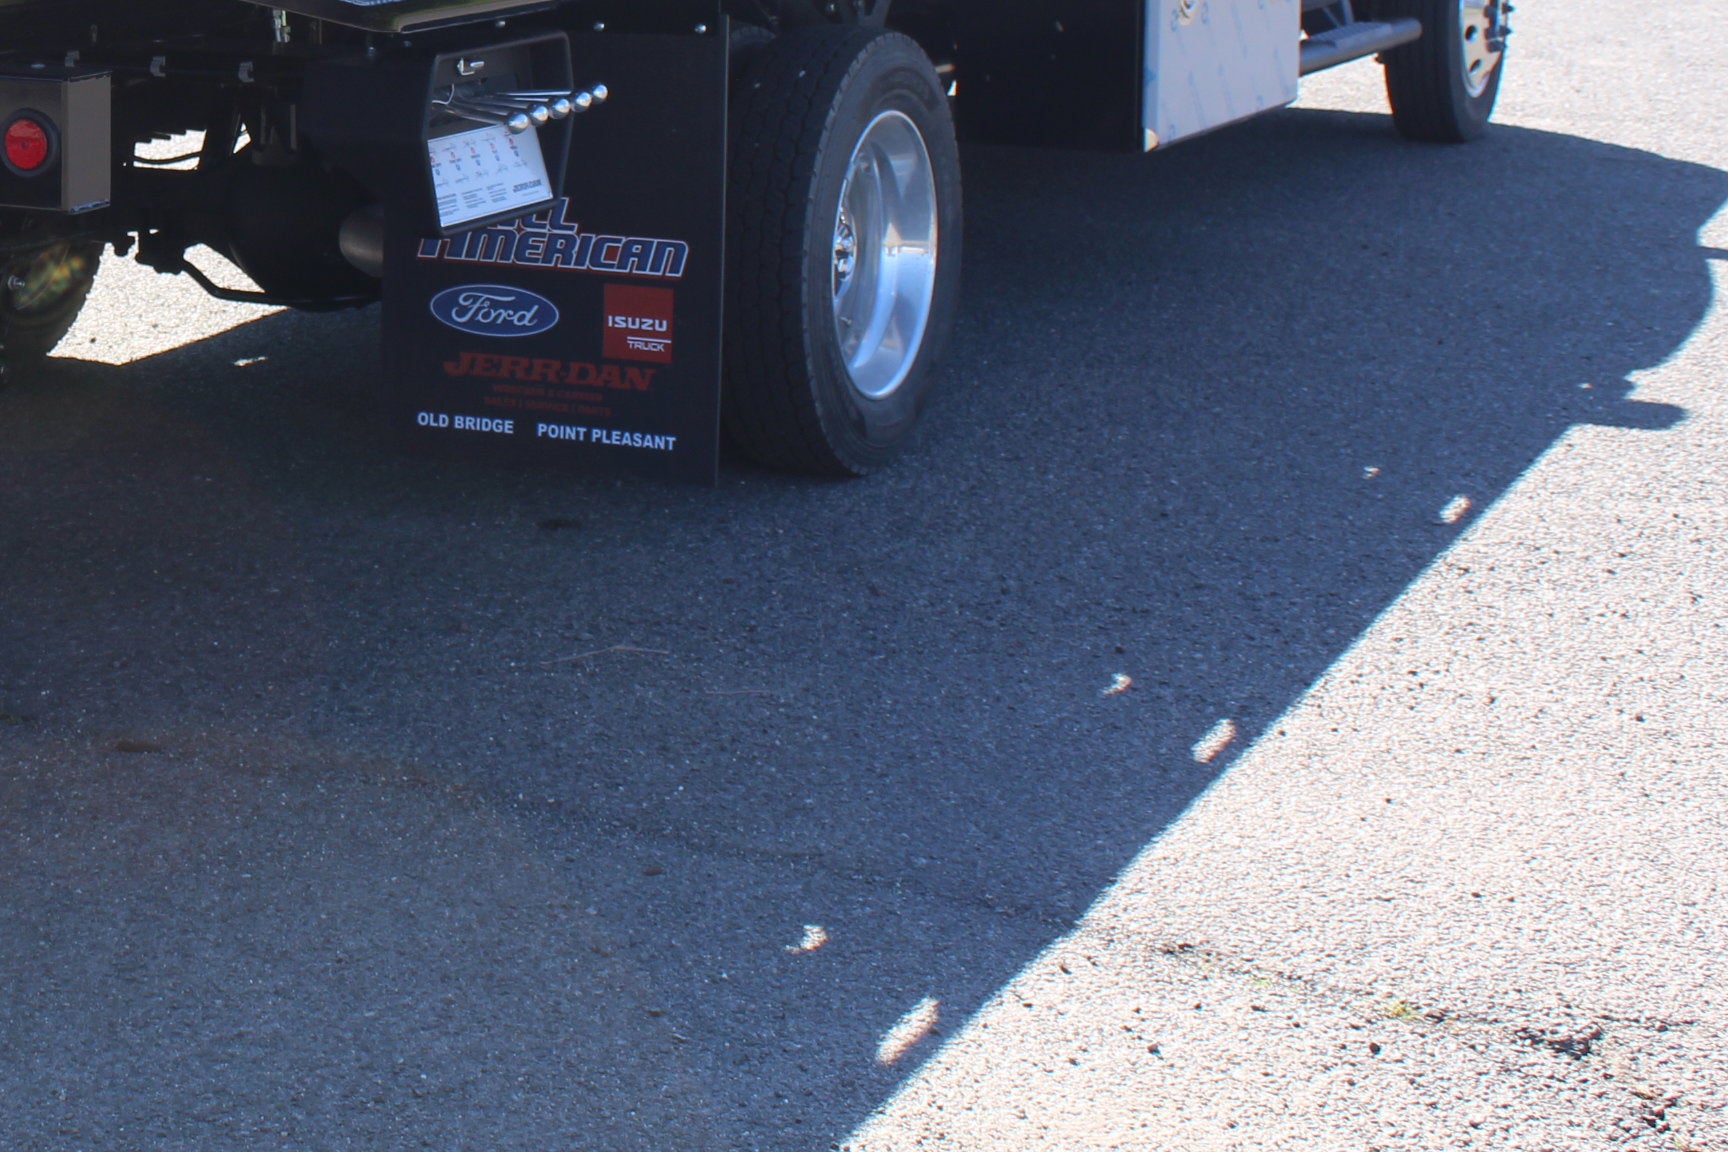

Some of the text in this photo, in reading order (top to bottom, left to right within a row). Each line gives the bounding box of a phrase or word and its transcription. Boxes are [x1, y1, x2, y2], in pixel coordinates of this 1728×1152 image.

[451, 292, 539, 327] Ford
[608, 315, 667, 332] ISUZU
[628, 341, 665, 352] TRUCK
[443, 352, 657, 391] JERR-DAN
[417, 412, 676, 451] OLD BRIDGE POINT PLEASANT
